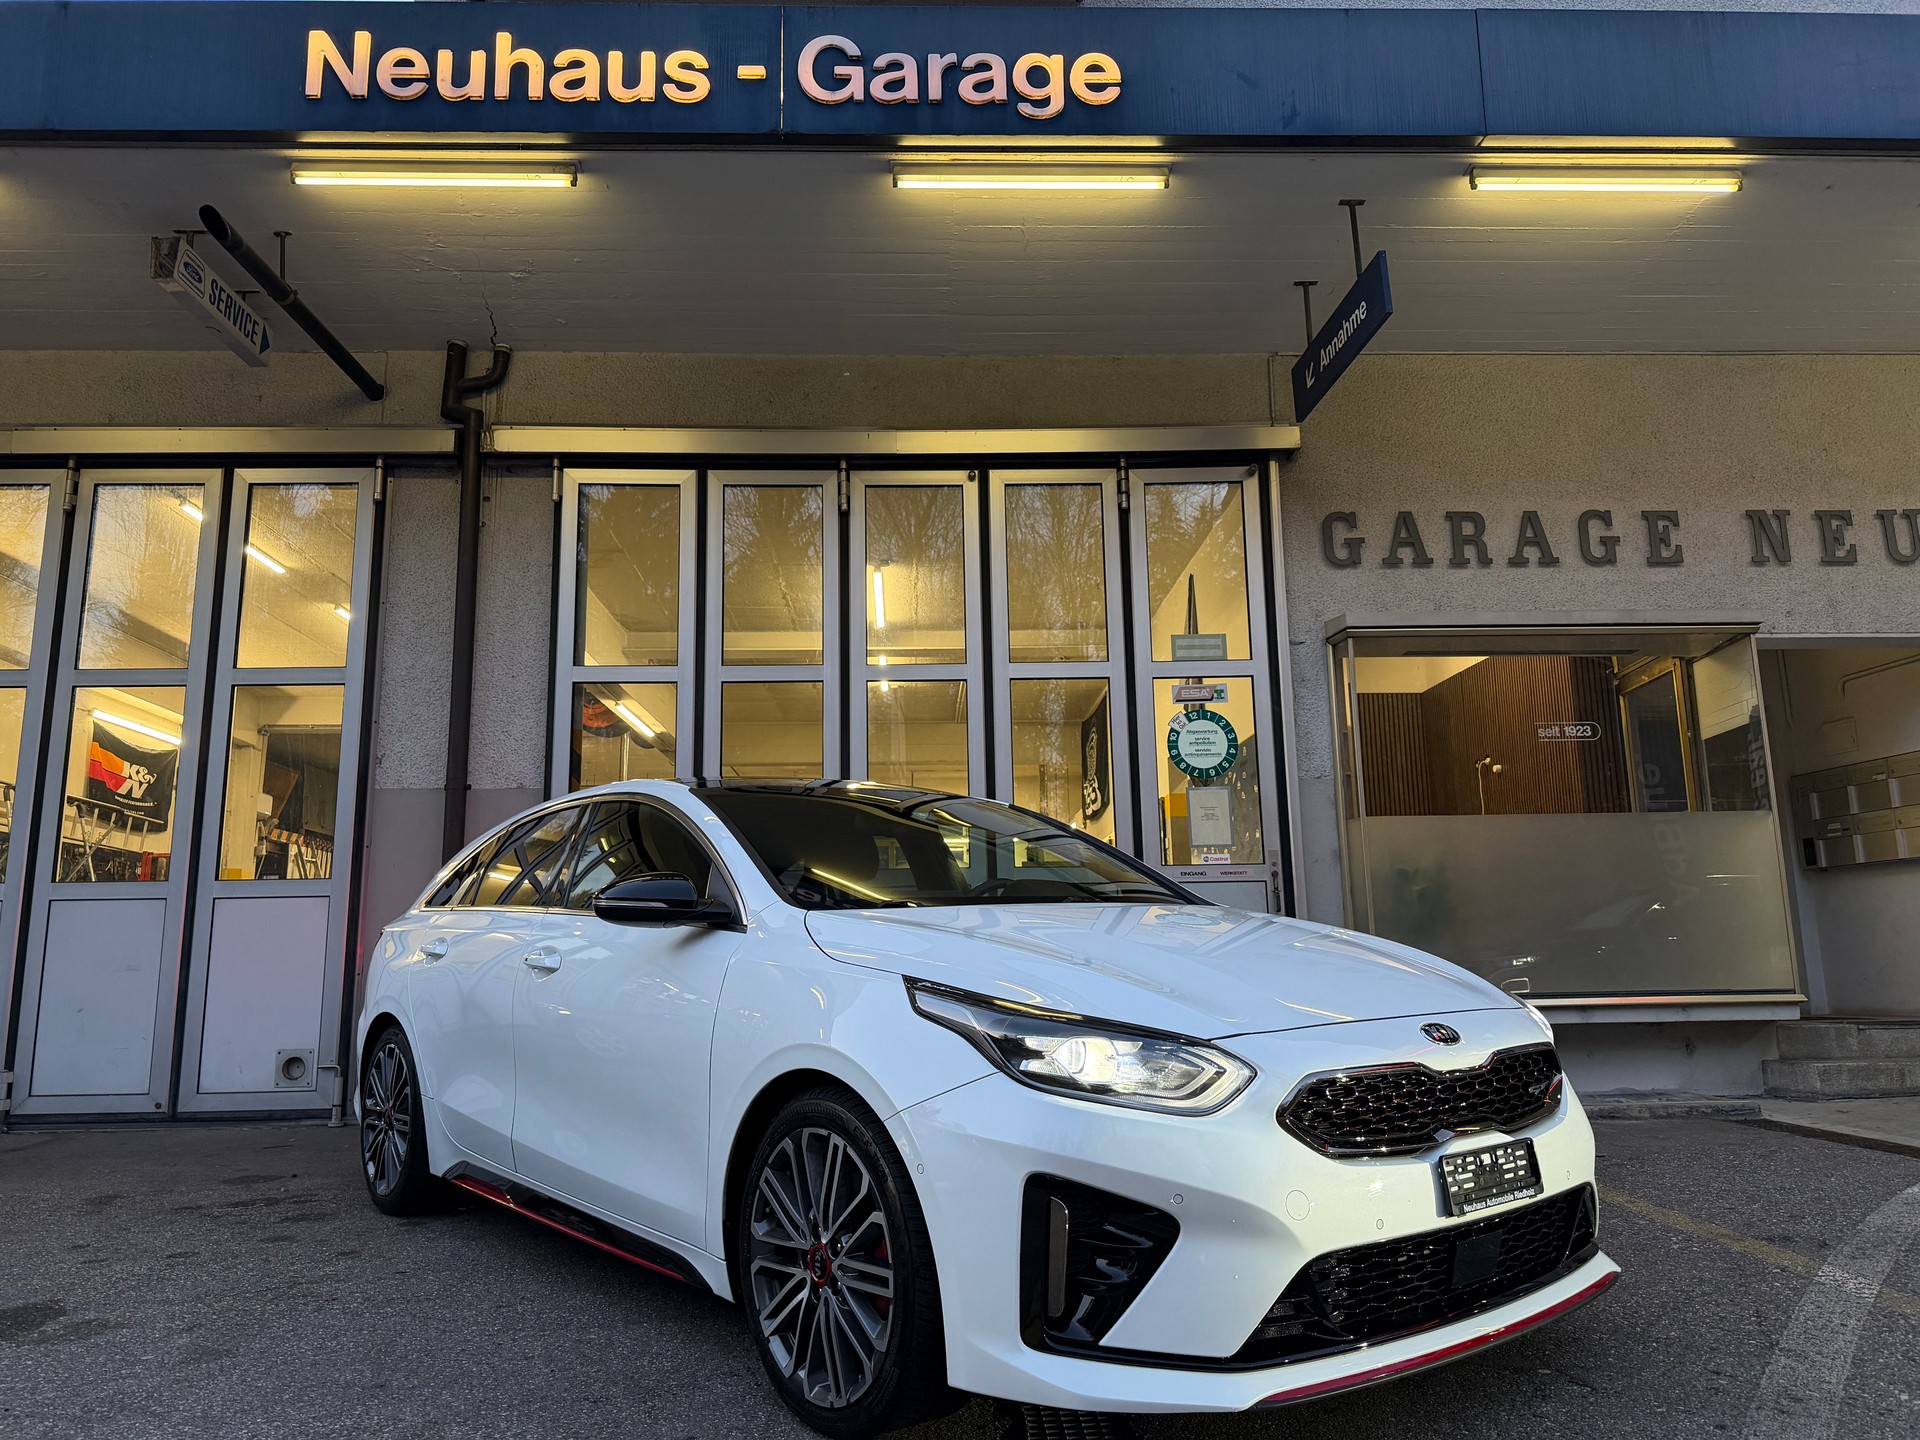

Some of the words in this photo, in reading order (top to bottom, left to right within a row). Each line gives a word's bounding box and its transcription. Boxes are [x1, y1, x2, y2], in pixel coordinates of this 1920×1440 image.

[304, 29, 710, 104] Neuhaus
[797, 34, 1122, 120] Garage
[208, 278, 260, 347] SERVICE
[1320, 300, 1367, 373] Annahme
[1321, 509, 1684, 566] GARAGE
[1745, 508, 1920, 564] NEU
[1169, 732, 1178, 741] 10
[1188, 711, 1198, 720] 12
[1537, 725, 1560, 737] seit
[1563, 725, 1592, 737] 1923
[1463, 1202, 1486, 1213] Neuhaus
[1486, 1192, 1514, 1207] Automobile
[1513, 1187, 1536, 1200] Riedholz
